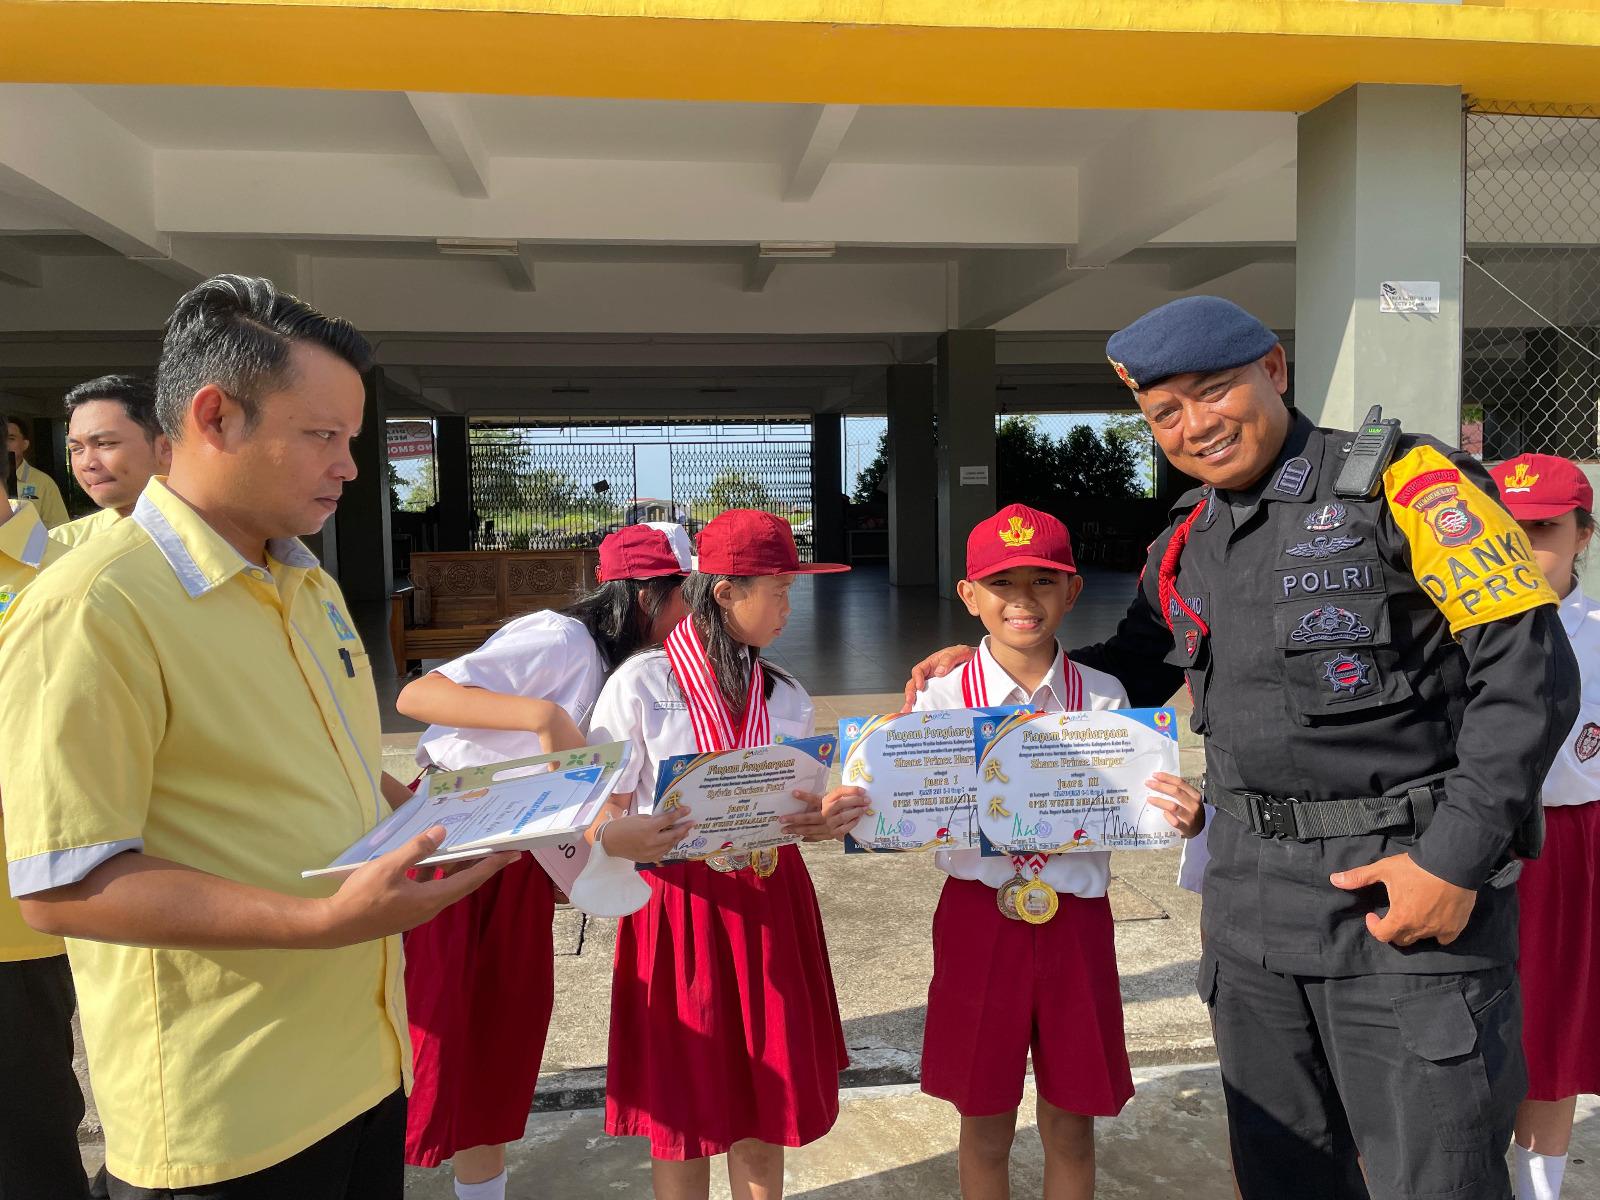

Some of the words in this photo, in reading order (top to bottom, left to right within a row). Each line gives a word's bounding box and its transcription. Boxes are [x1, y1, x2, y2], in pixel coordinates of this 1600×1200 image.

[1420, 532, 1531, 604] DANKI
[1283, 565, 1373, 597] POLRI
[1458, 564, 1539, 616] PRC
[887, 729, 923, 742] Piagam
[1023, 730, 1060, 743] Piagam
[1062, 727, 1129, 742] Penghargaan
[893, 799, 912, 808] OPEN
[1028, 800, 1047, 808] OPEN
